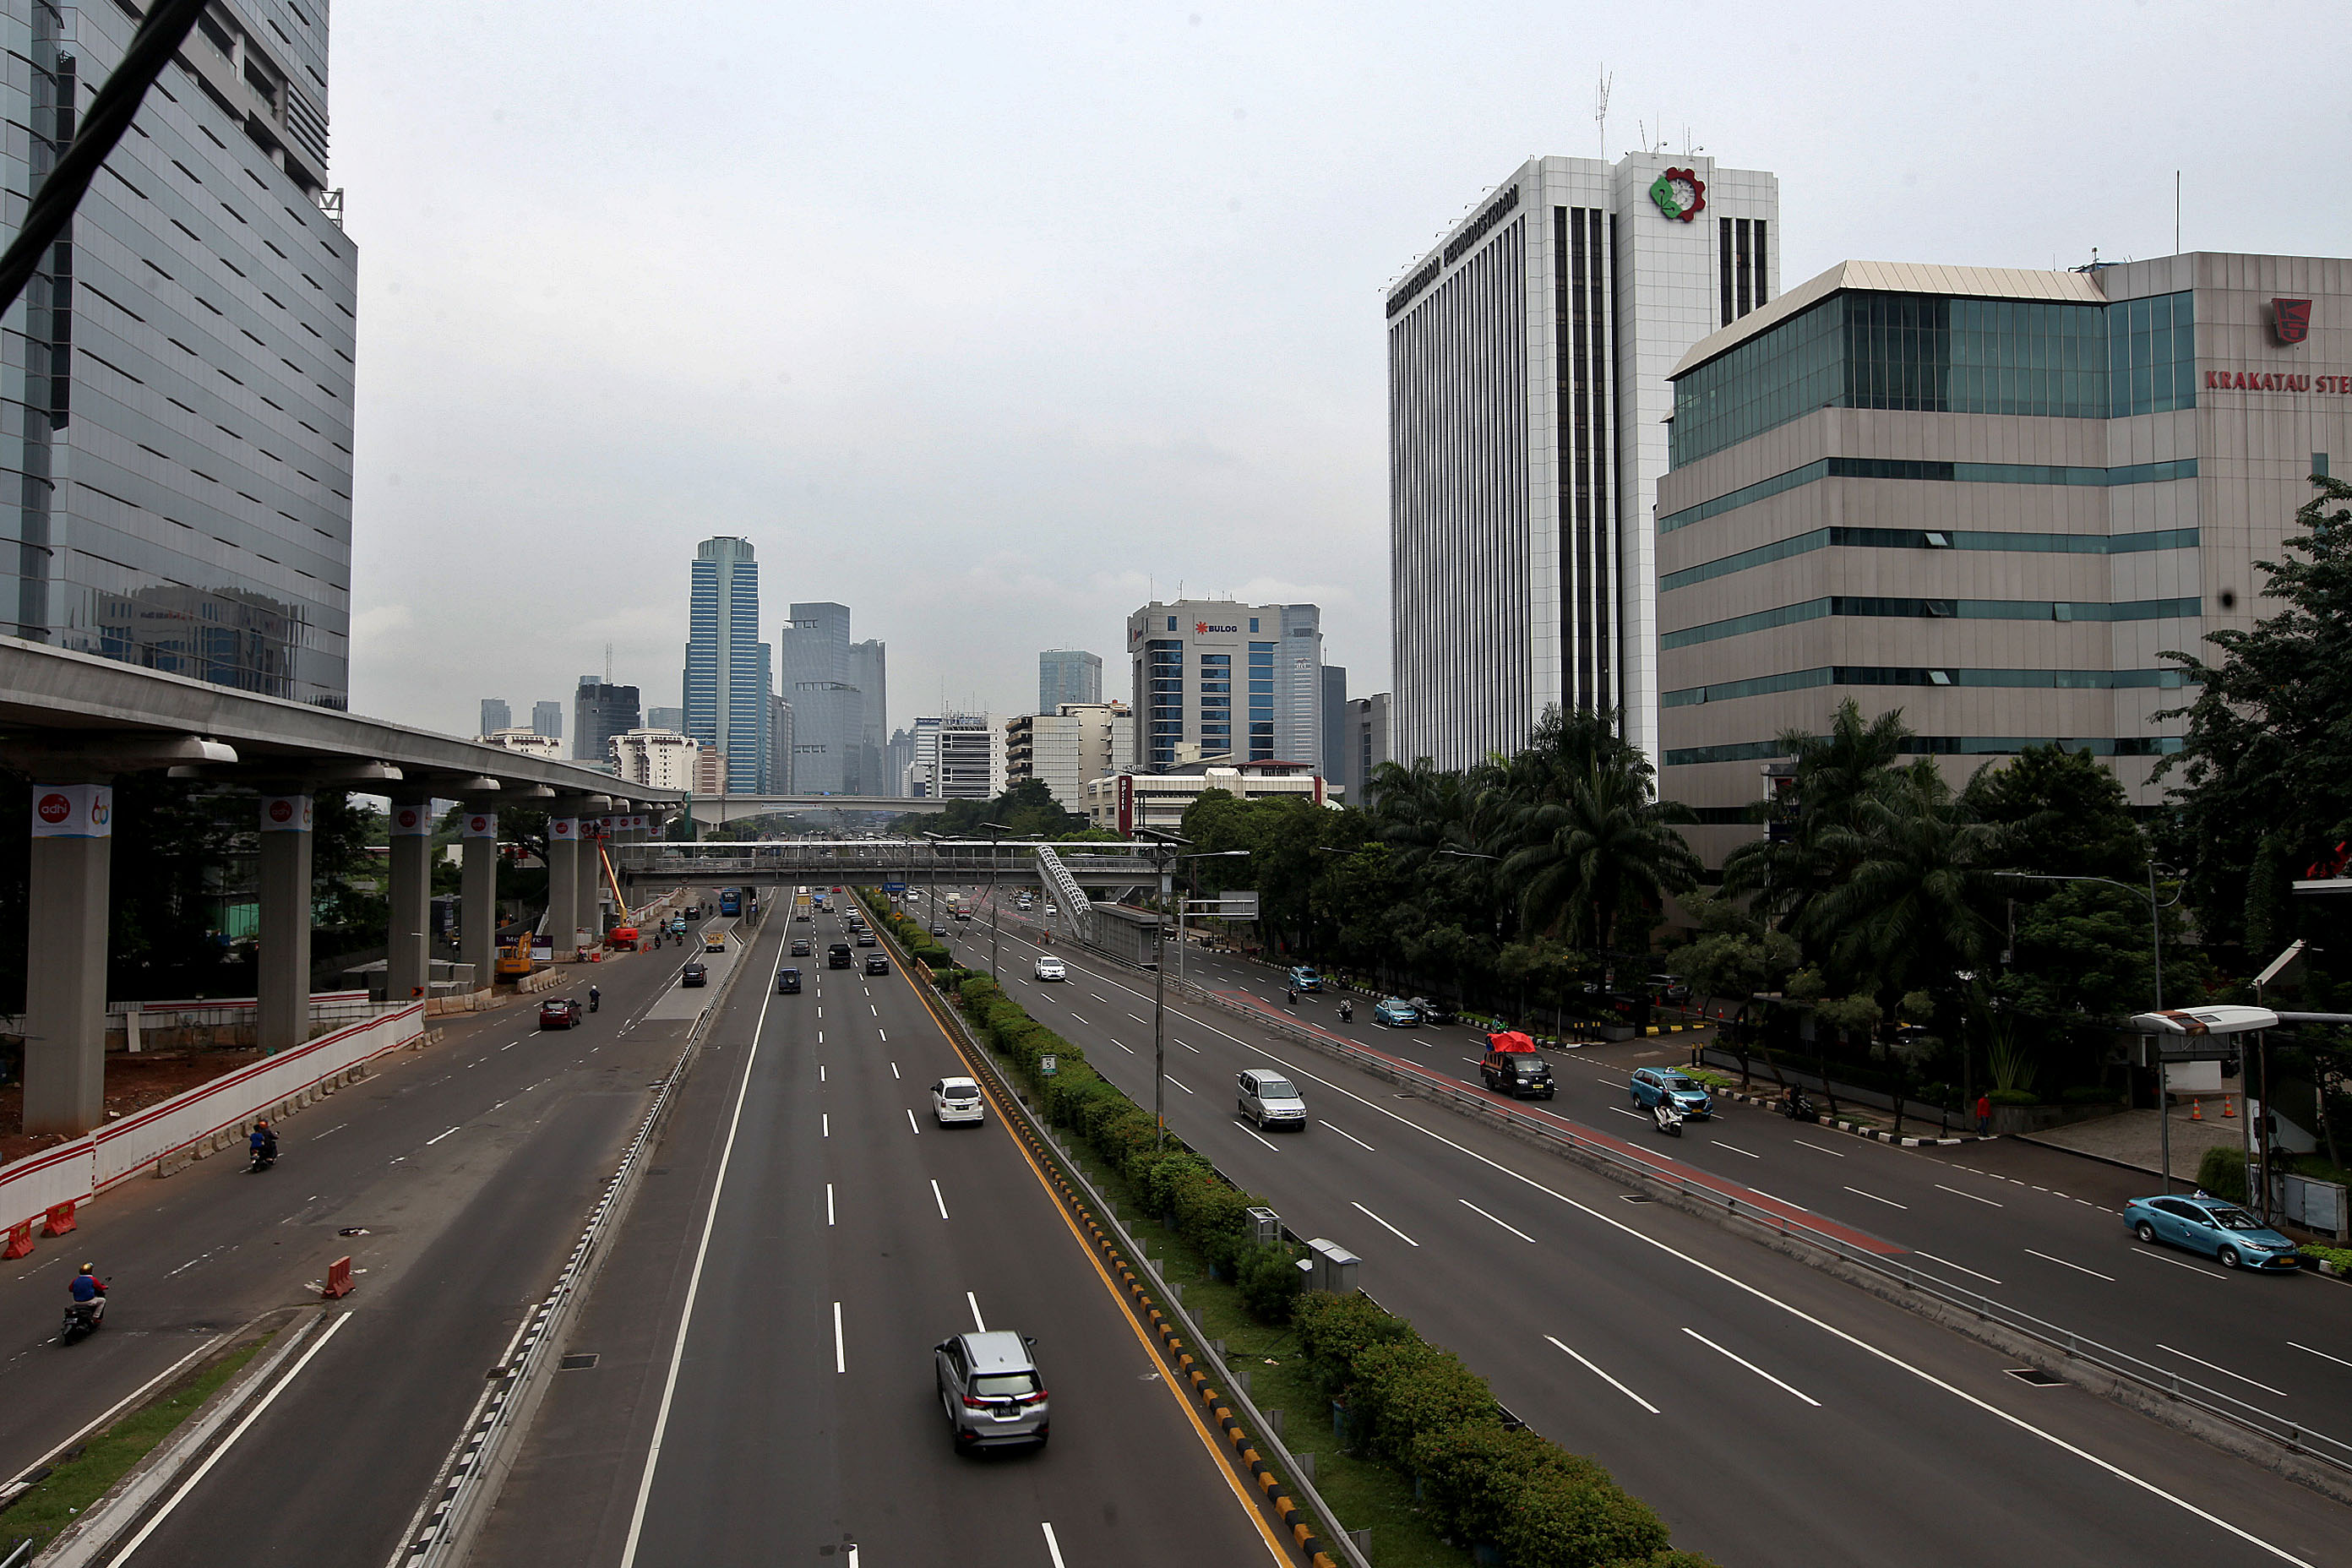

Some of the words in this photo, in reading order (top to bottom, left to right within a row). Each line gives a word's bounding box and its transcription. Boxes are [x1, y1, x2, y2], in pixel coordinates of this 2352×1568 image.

[1386, 256, 1440, 318] KEMENTERIAN
[1443, 183, 1519, 268] PERINDUSTRIAN
[2205, 370, 2311, 392] KRAKATAU
[41, 803, 68, 814] adhi
